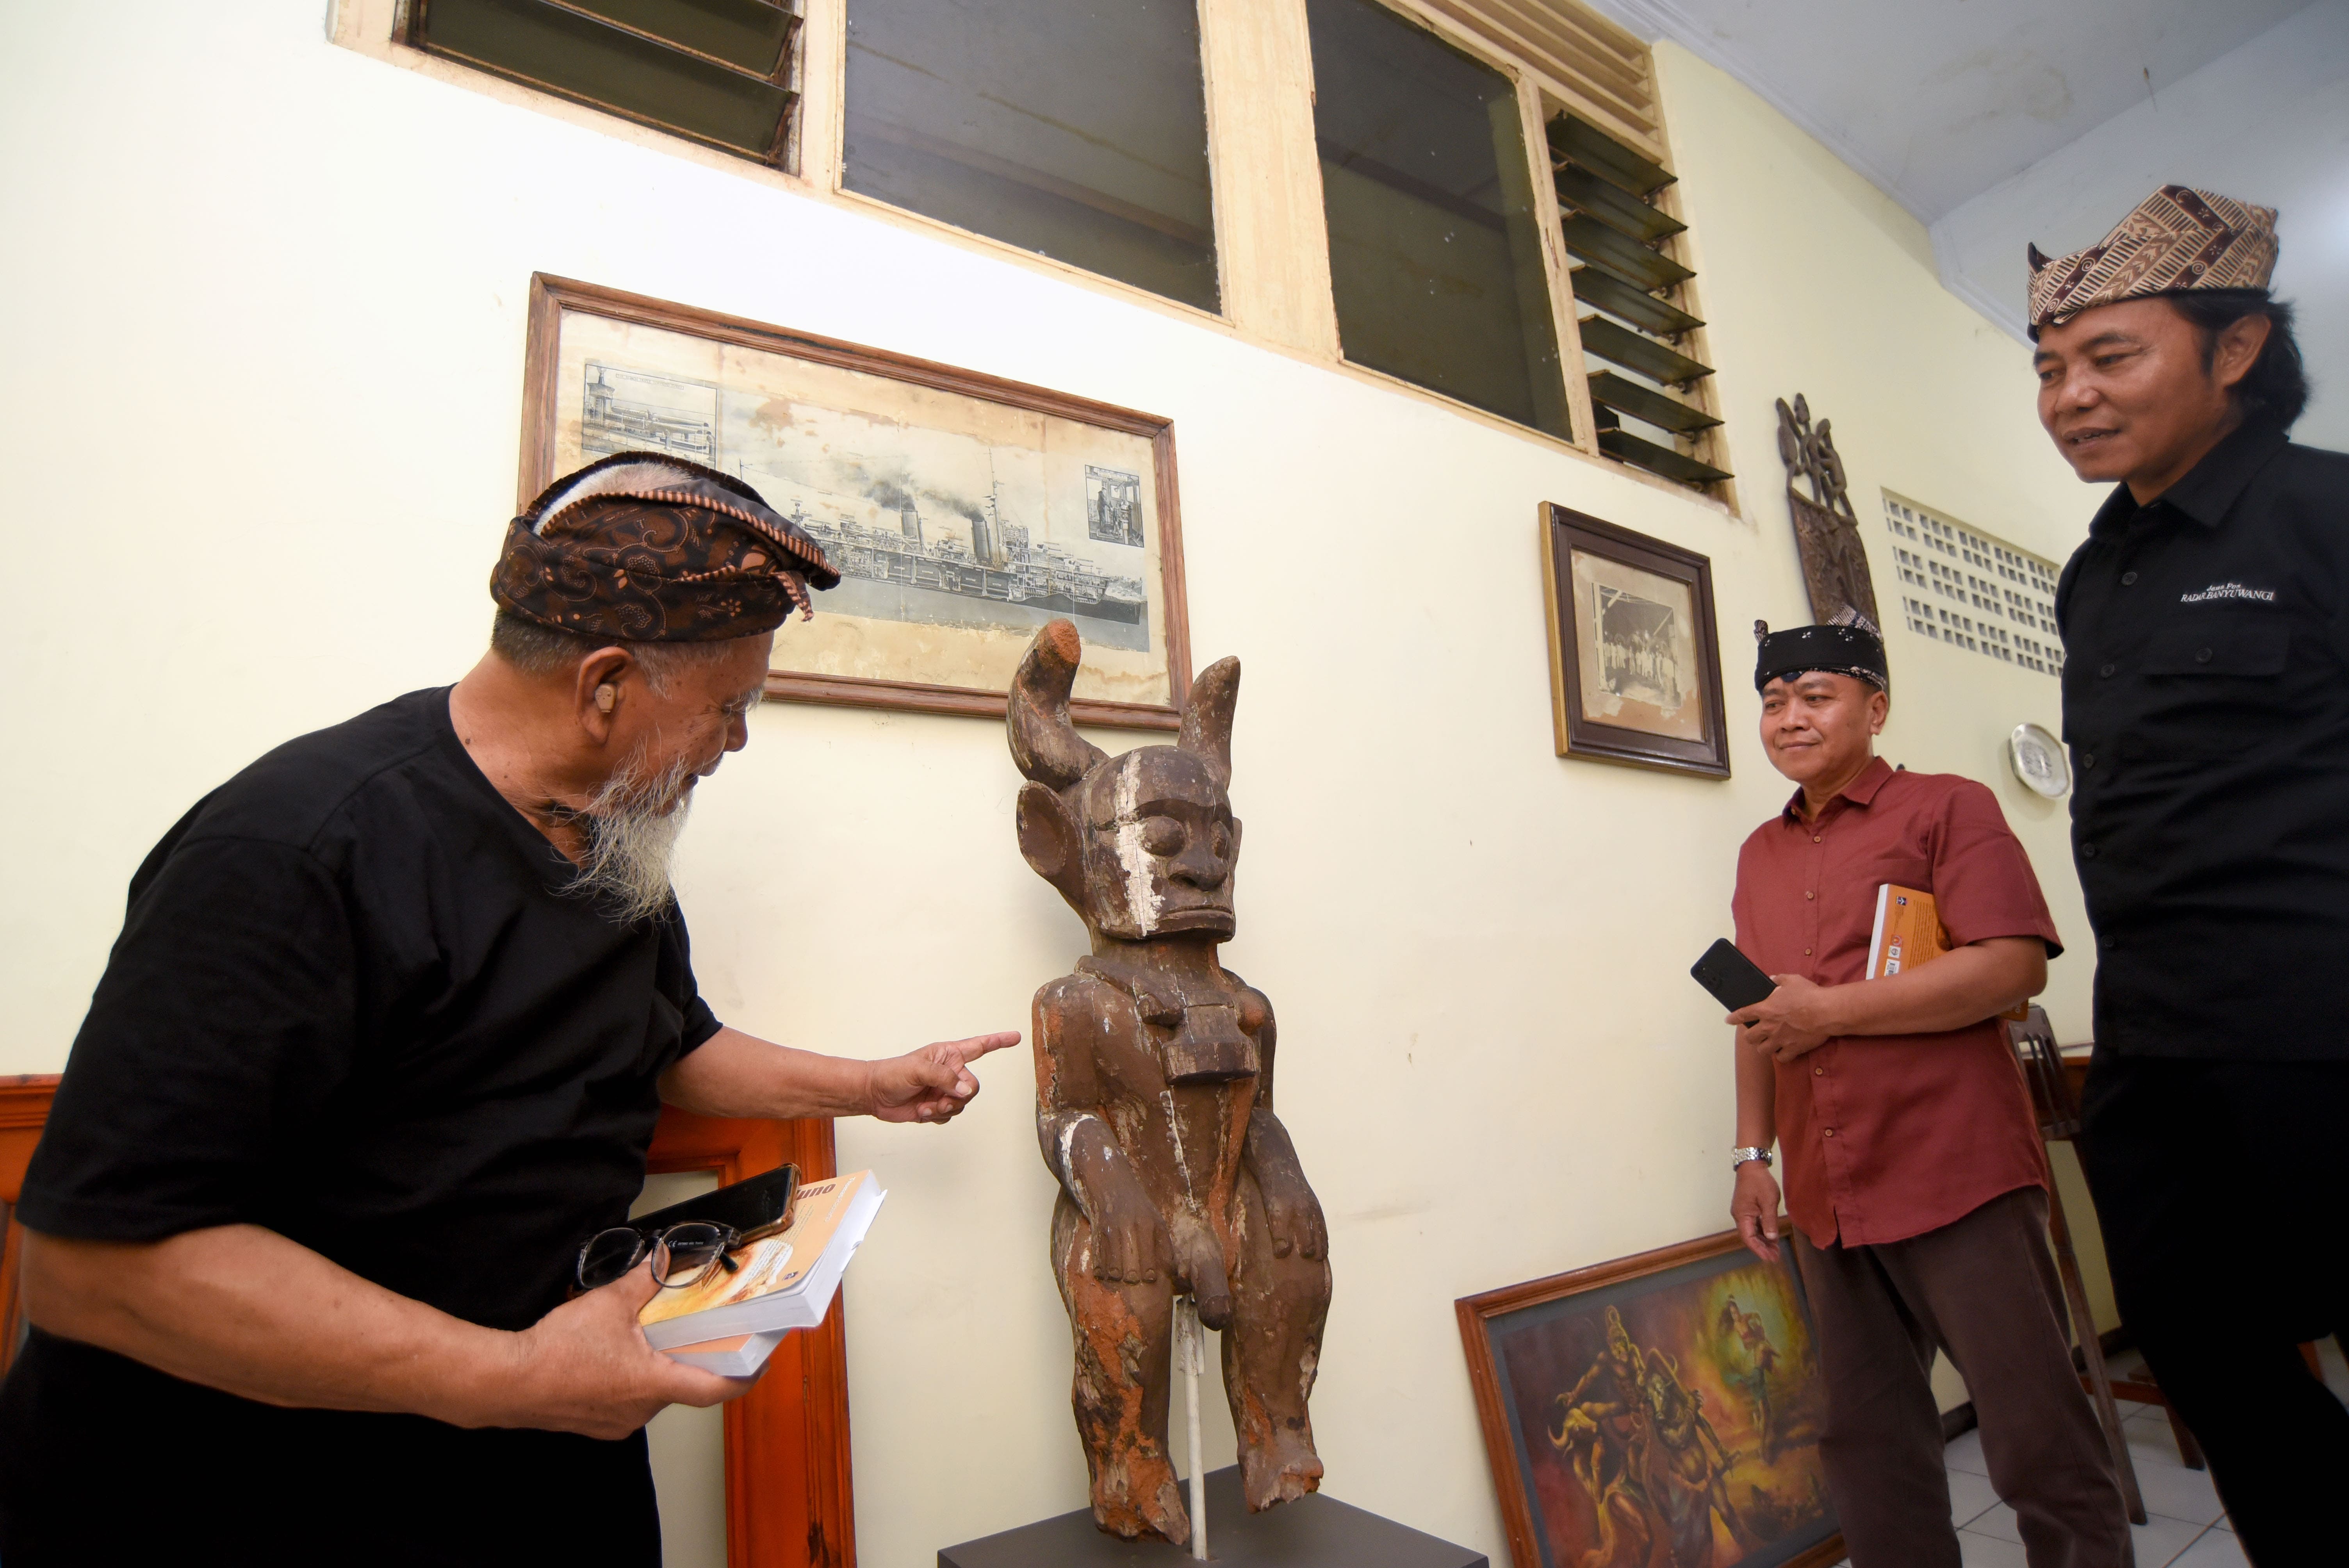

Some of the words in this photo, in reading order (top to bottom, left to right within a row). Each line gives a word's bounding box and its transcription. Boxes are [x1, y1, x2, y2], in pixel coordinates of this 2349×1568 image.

[2180, 592, 2206, 602] RADAR
[2206, 589, 2274, 601] BANYUWANGI
[797, 1184, 836, 1200] uno
